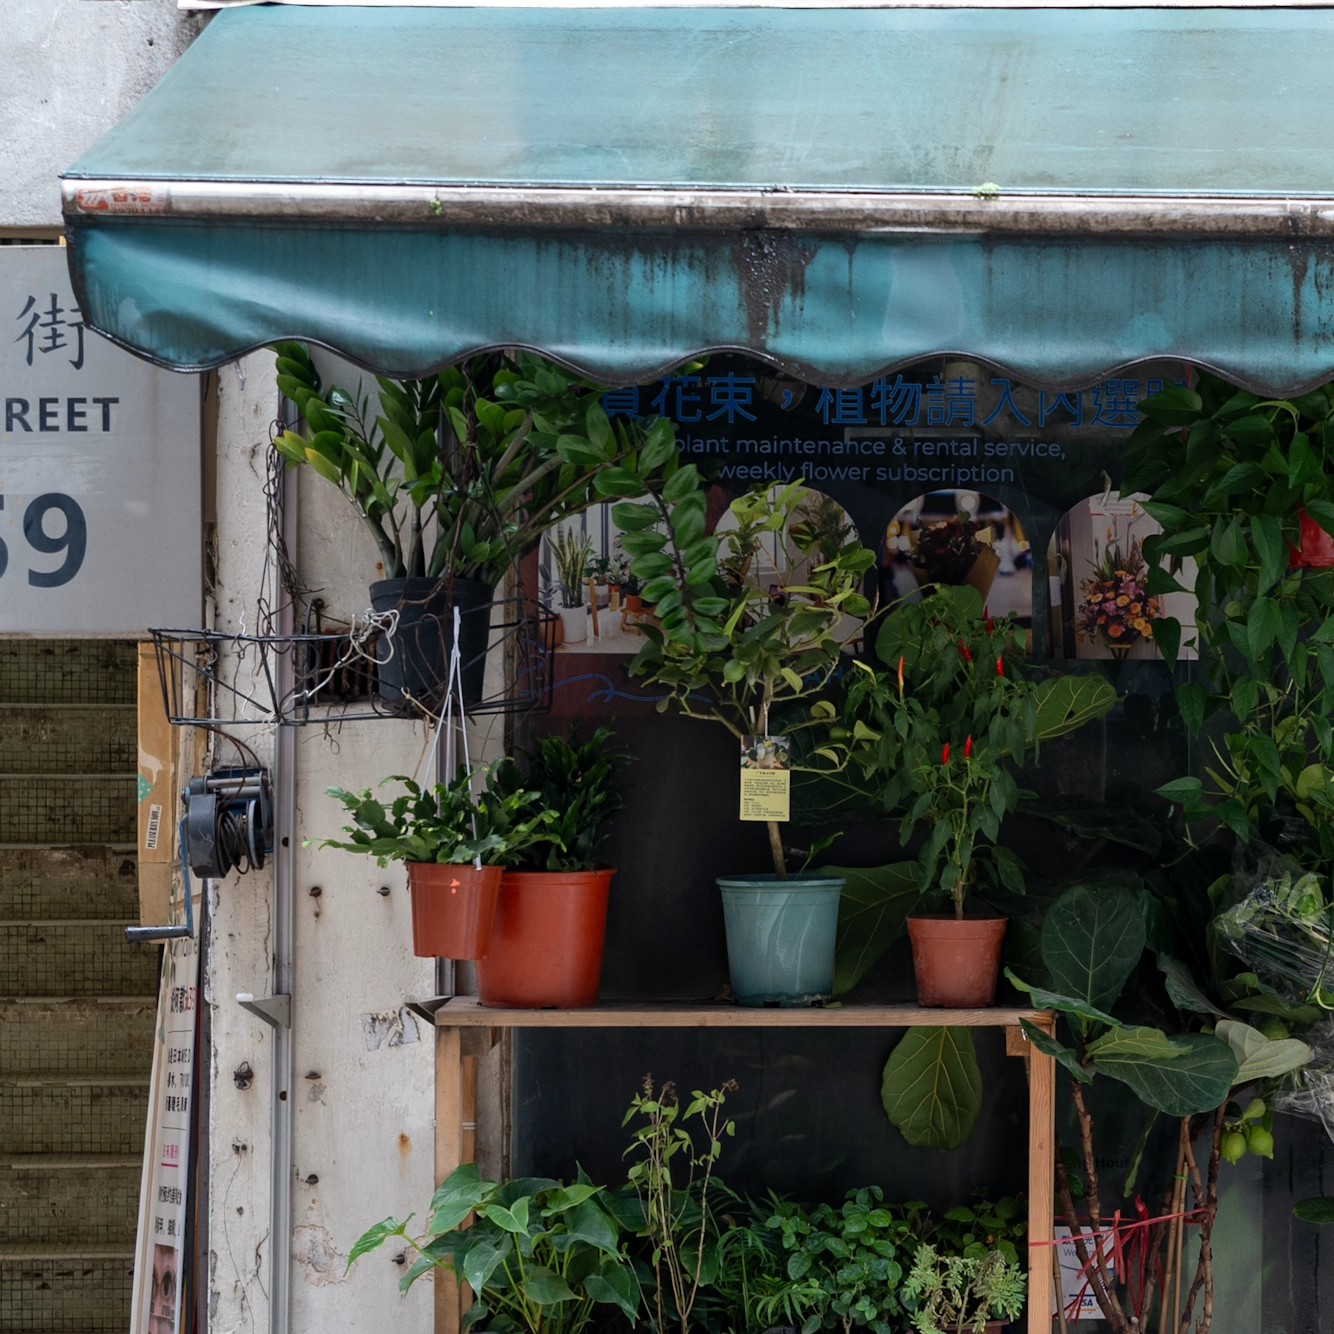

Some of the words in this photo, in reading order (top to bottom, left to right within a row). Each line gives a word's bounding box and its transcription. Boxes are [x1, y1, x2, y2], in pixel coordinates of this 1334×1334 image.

[14, 292, 90, 371] 街
[4, 396, 120, 433] REET
[734, 435, 886, 455] maintenance
[891, 437, 908, 456] &
[913, 438, 979, 457] rental
[984, 440, 1066, 462] service,
[718, 462, 795, 484] weekly
[799, 462, 870, 481] flower
[875, 464, 1015, 485] subscription
